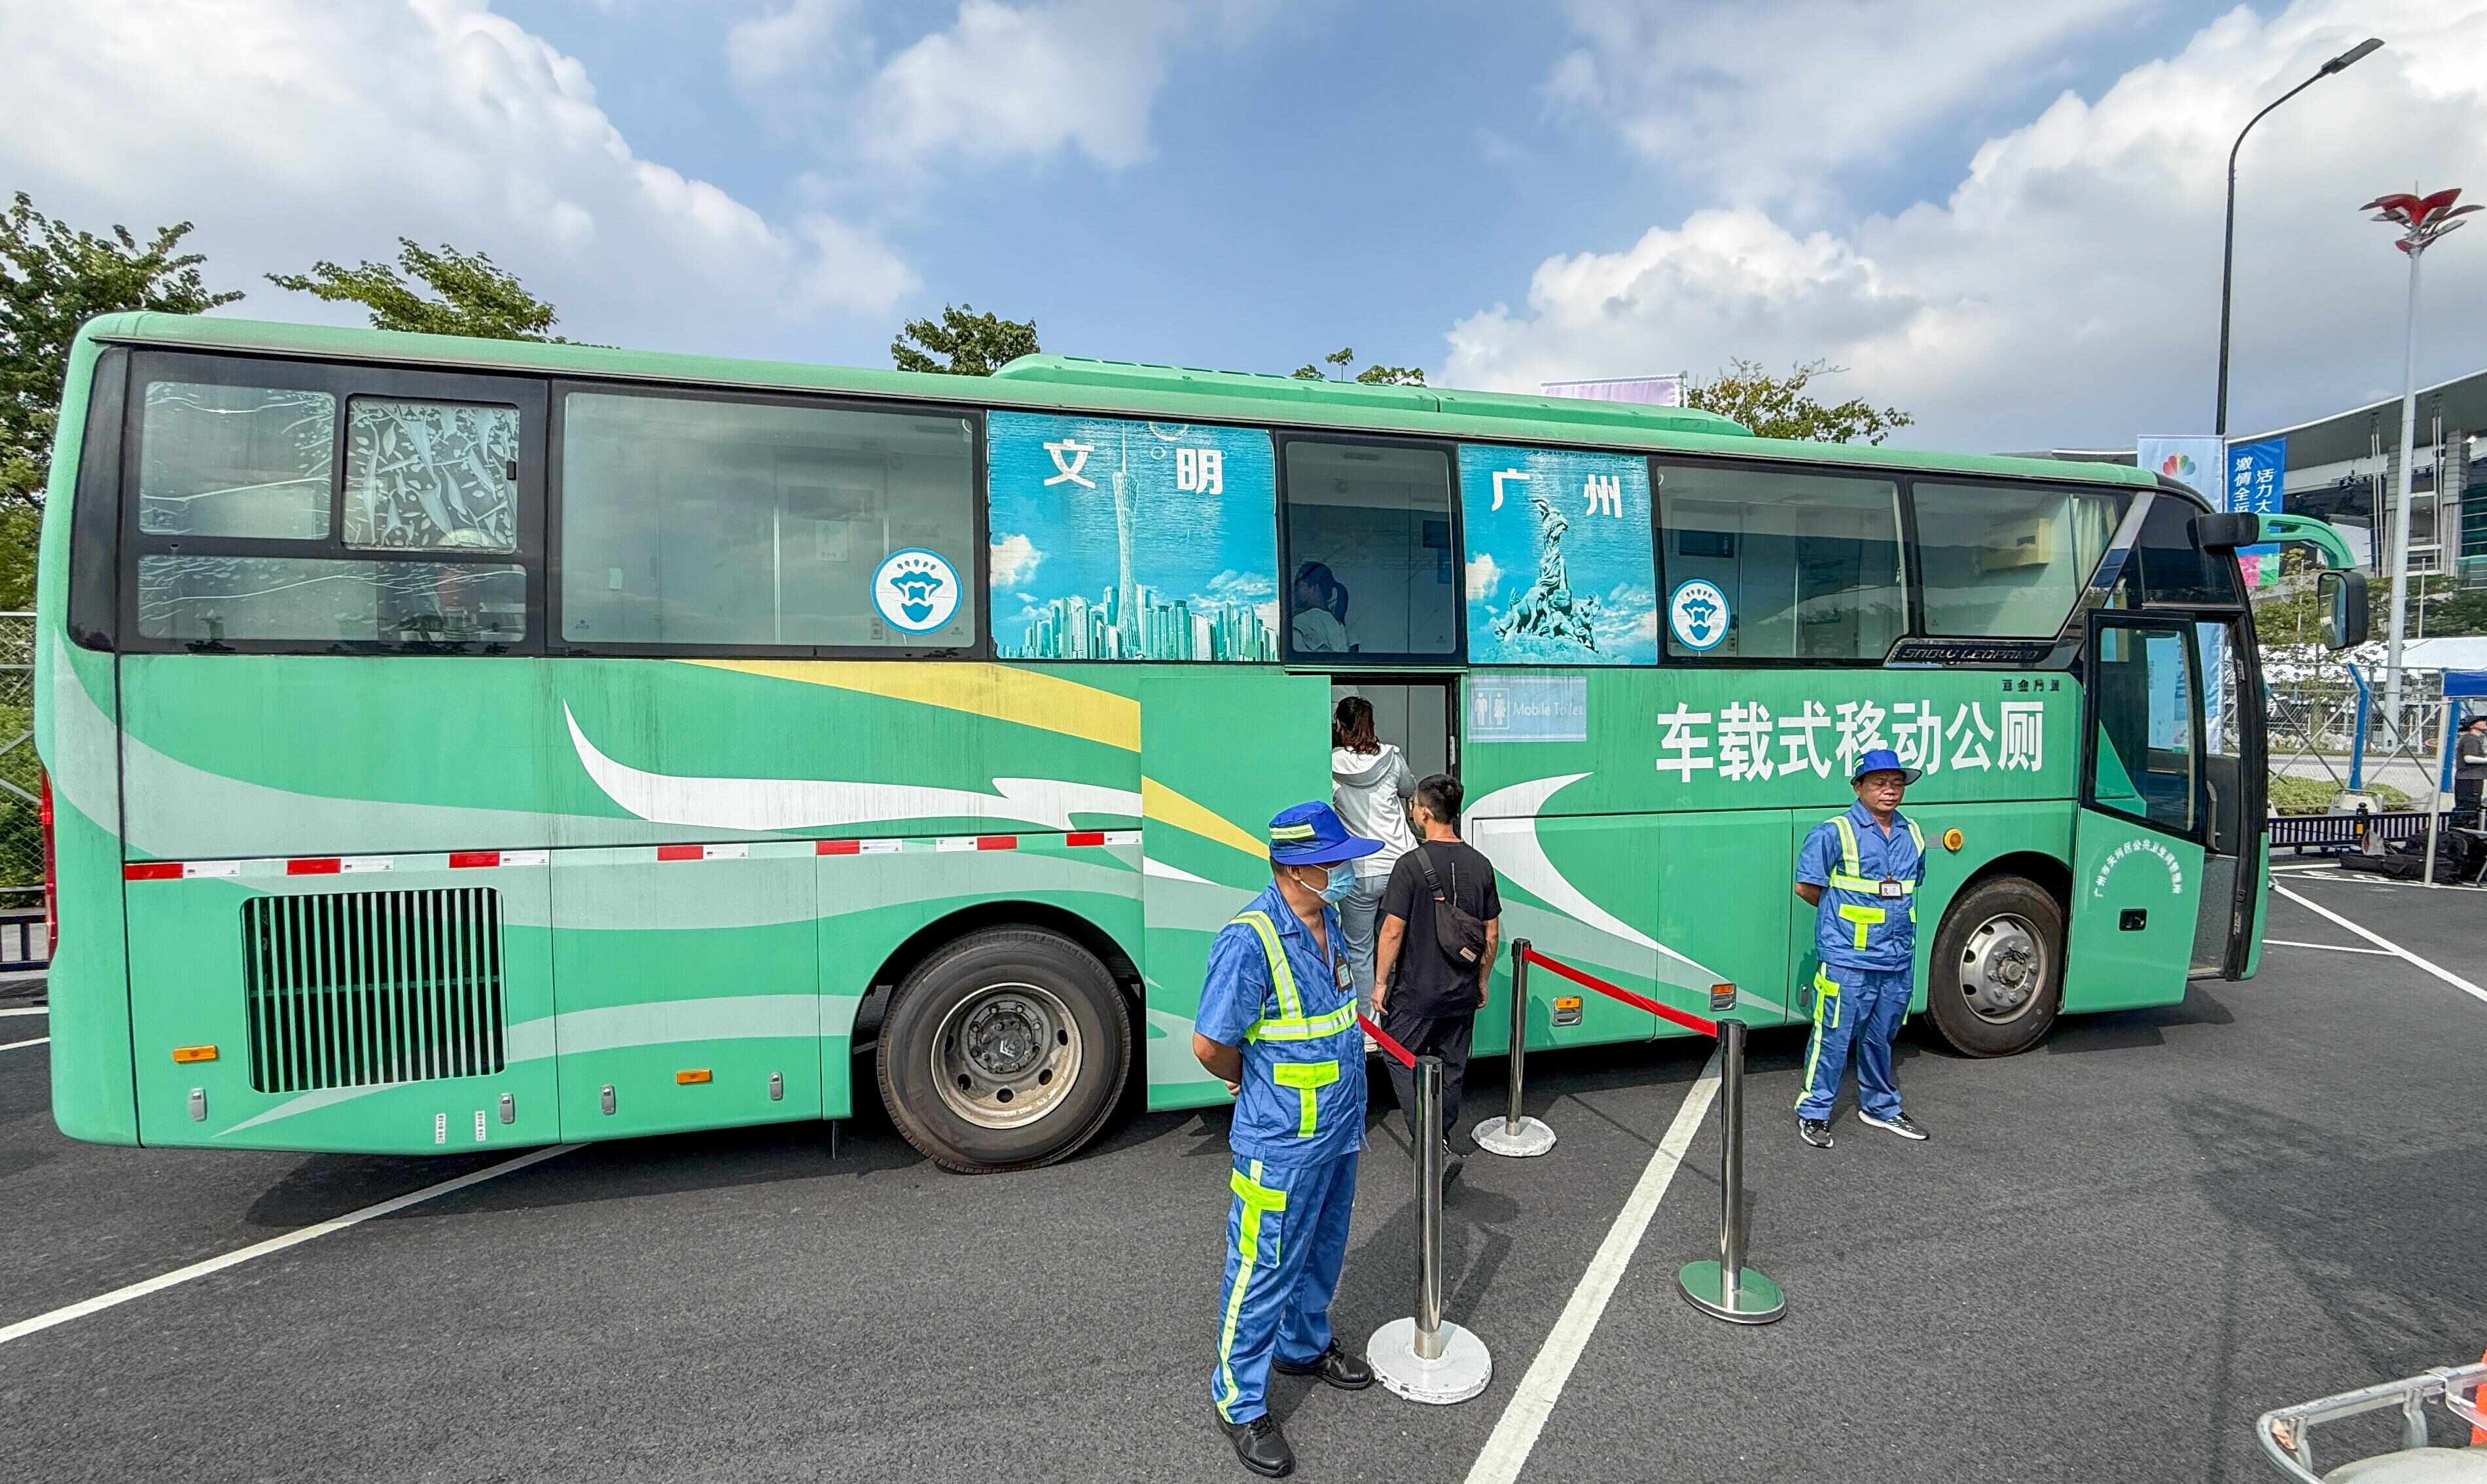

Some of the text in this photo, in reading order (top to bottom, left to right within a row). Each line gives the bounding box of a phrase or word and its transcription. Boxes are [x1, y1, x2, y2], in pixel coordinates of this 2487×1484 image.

[1512, 701, 1583, 716] Mobile Toilet
[1656, 699, 2044, 783] 车载式移动公厕
